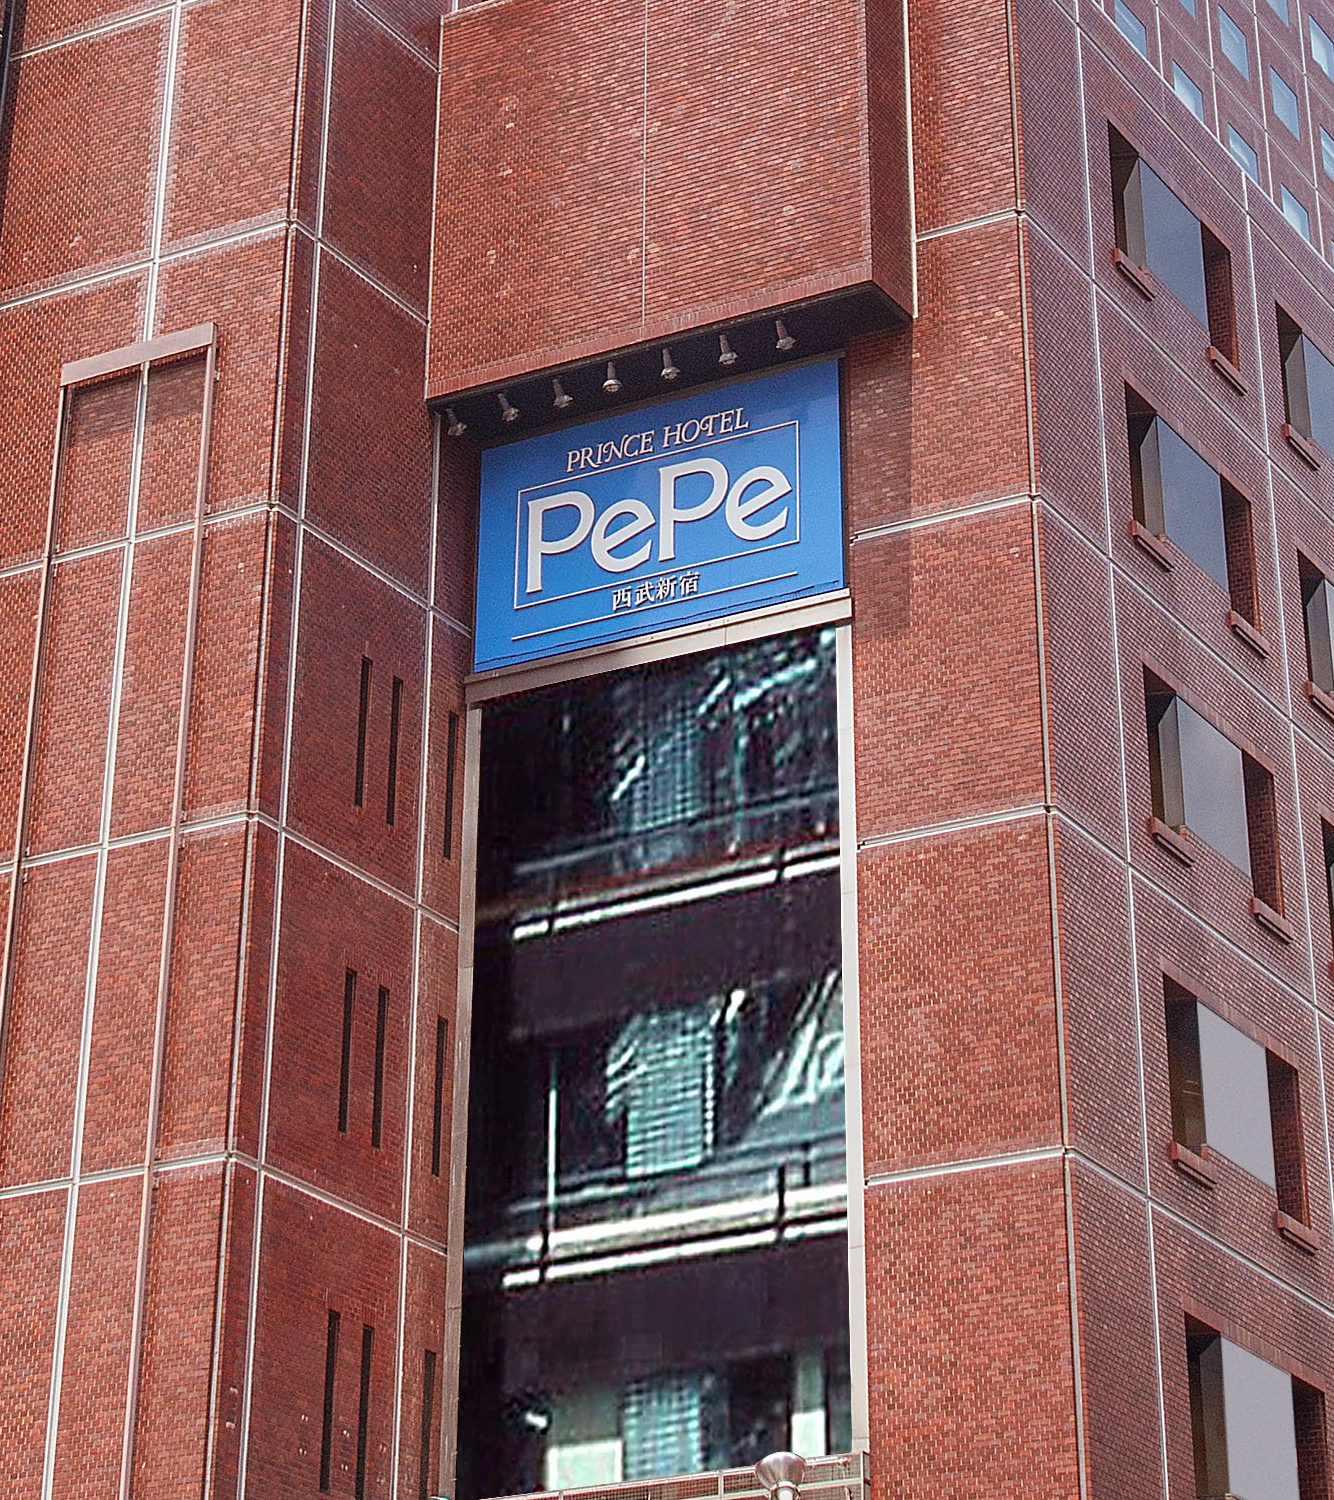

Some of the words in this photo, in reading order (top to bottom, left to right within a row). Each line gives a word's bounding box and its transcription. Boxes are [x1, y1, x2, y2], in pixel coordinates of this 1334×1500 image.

[566, 431, 654, 472] PRINCE
[662, 408, 749, 448] HOTEL
[525, 458, 792, 594] PePe
[611, 571, 700, 611] 西武新宿
